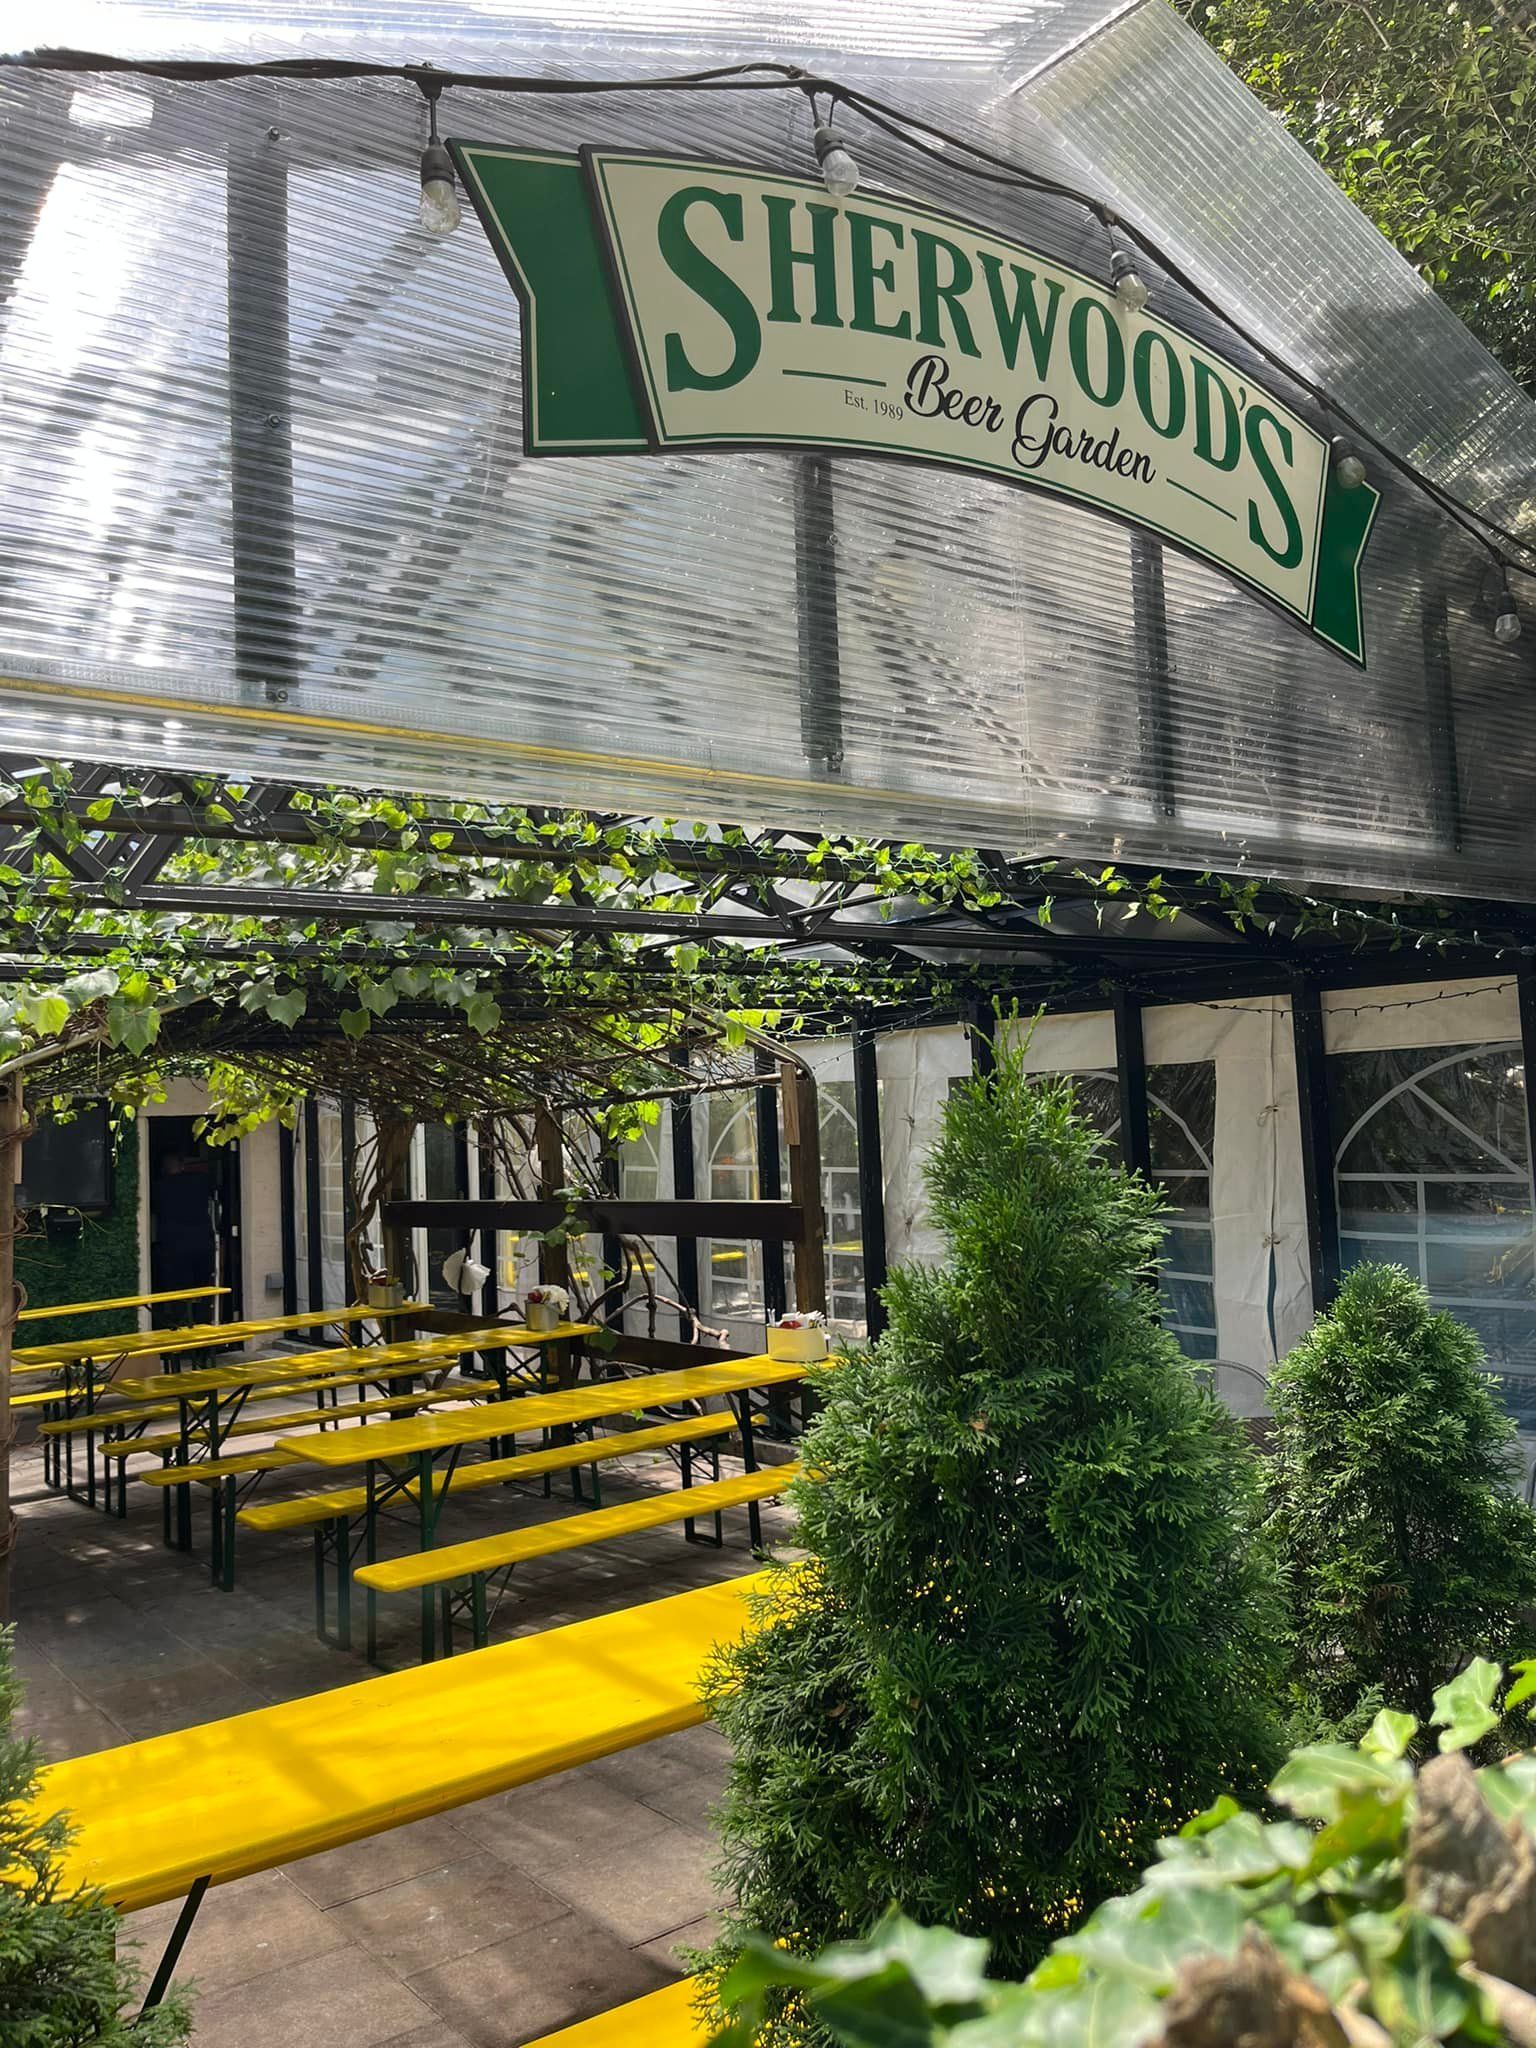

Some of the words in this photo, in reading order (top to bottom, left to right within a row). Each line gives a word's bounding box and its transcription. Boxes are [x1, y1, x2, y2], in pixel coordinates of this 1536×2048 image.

[657, 186, 1303, 570] SHERWOOD'S
[845, 390, 869, 411] Est.
[874, 399, 903, 421] 1989
[904, 355, 1004, 433] Beer
[1011, 394, 1156, 484] Garden
